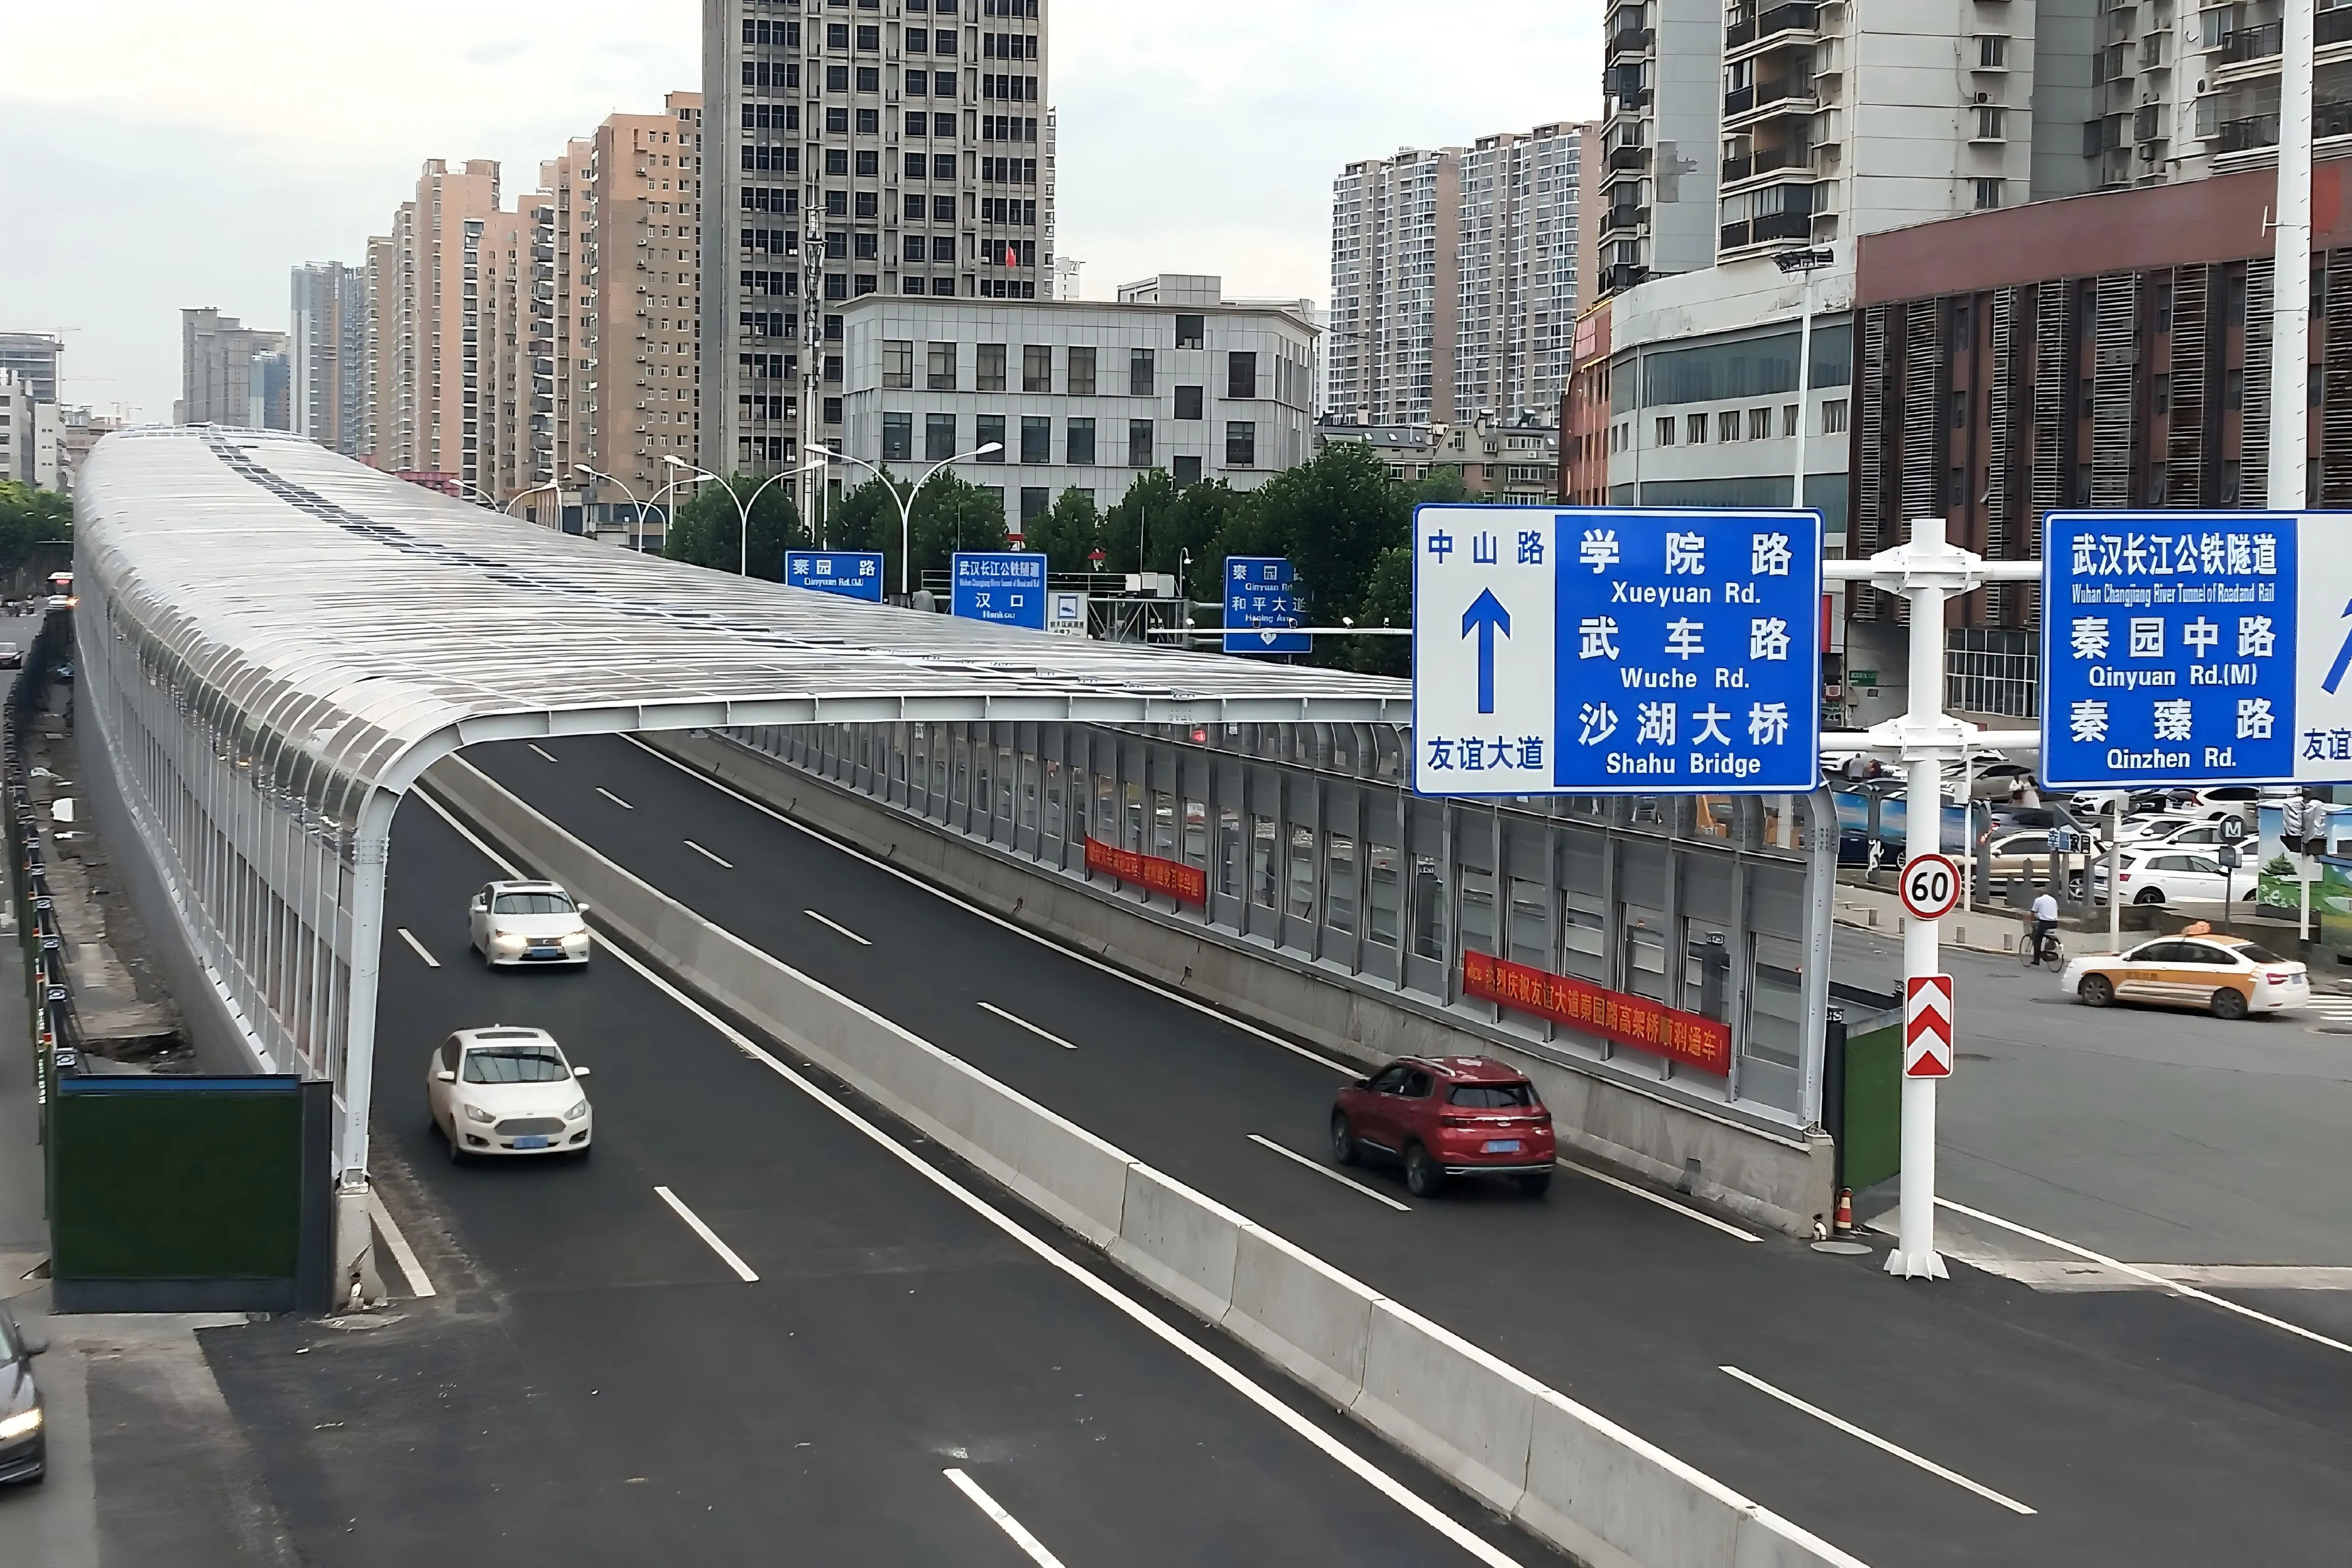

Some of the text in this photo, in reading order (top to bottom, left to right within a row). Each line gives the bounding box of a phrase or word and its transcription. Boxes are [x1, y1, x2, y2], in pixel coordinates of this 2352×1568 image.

[1428, 529, 1545, 565] 中山路
[1580, 528, 1793, 576] 学院路
[2072, 532, 2277, 576] 武汉长江公铁隧道
[975, 592, 1023, 608] 汉口
[1611, 581, 1760, 607] Xueyuan Rd.
[2072, 583, 2101, 603] Wuhan
[2104, 583, 2151, 607] Changjiang
[2153, 583, 2175, 603] River
[2177, 583, 2206, 603] Tunnel
[2207, 582, 2217, 602] of
[2259, 582, 2274, 602] Rail
[1579, 616, 1791, 660] 武车路
[2070, 615, 2276, 659] 秦园中路
[1620, 668, 1749, 688] Wuche Rd.
[2089, 663, 2257, 691] Qinyuan Rd.(M)
[1578, 701, 1788, 746] 沙湖大桥
[2070, 698, 2275, 742] 秦臻路
[1427, 735, 1544, 771] 友谊大道
[1606, 752, 1761, 778] Shahu Bridge
[2107, 747, 2236, 769] Qinzhen Rd.
[1911, 872, 1949, 902] 60
